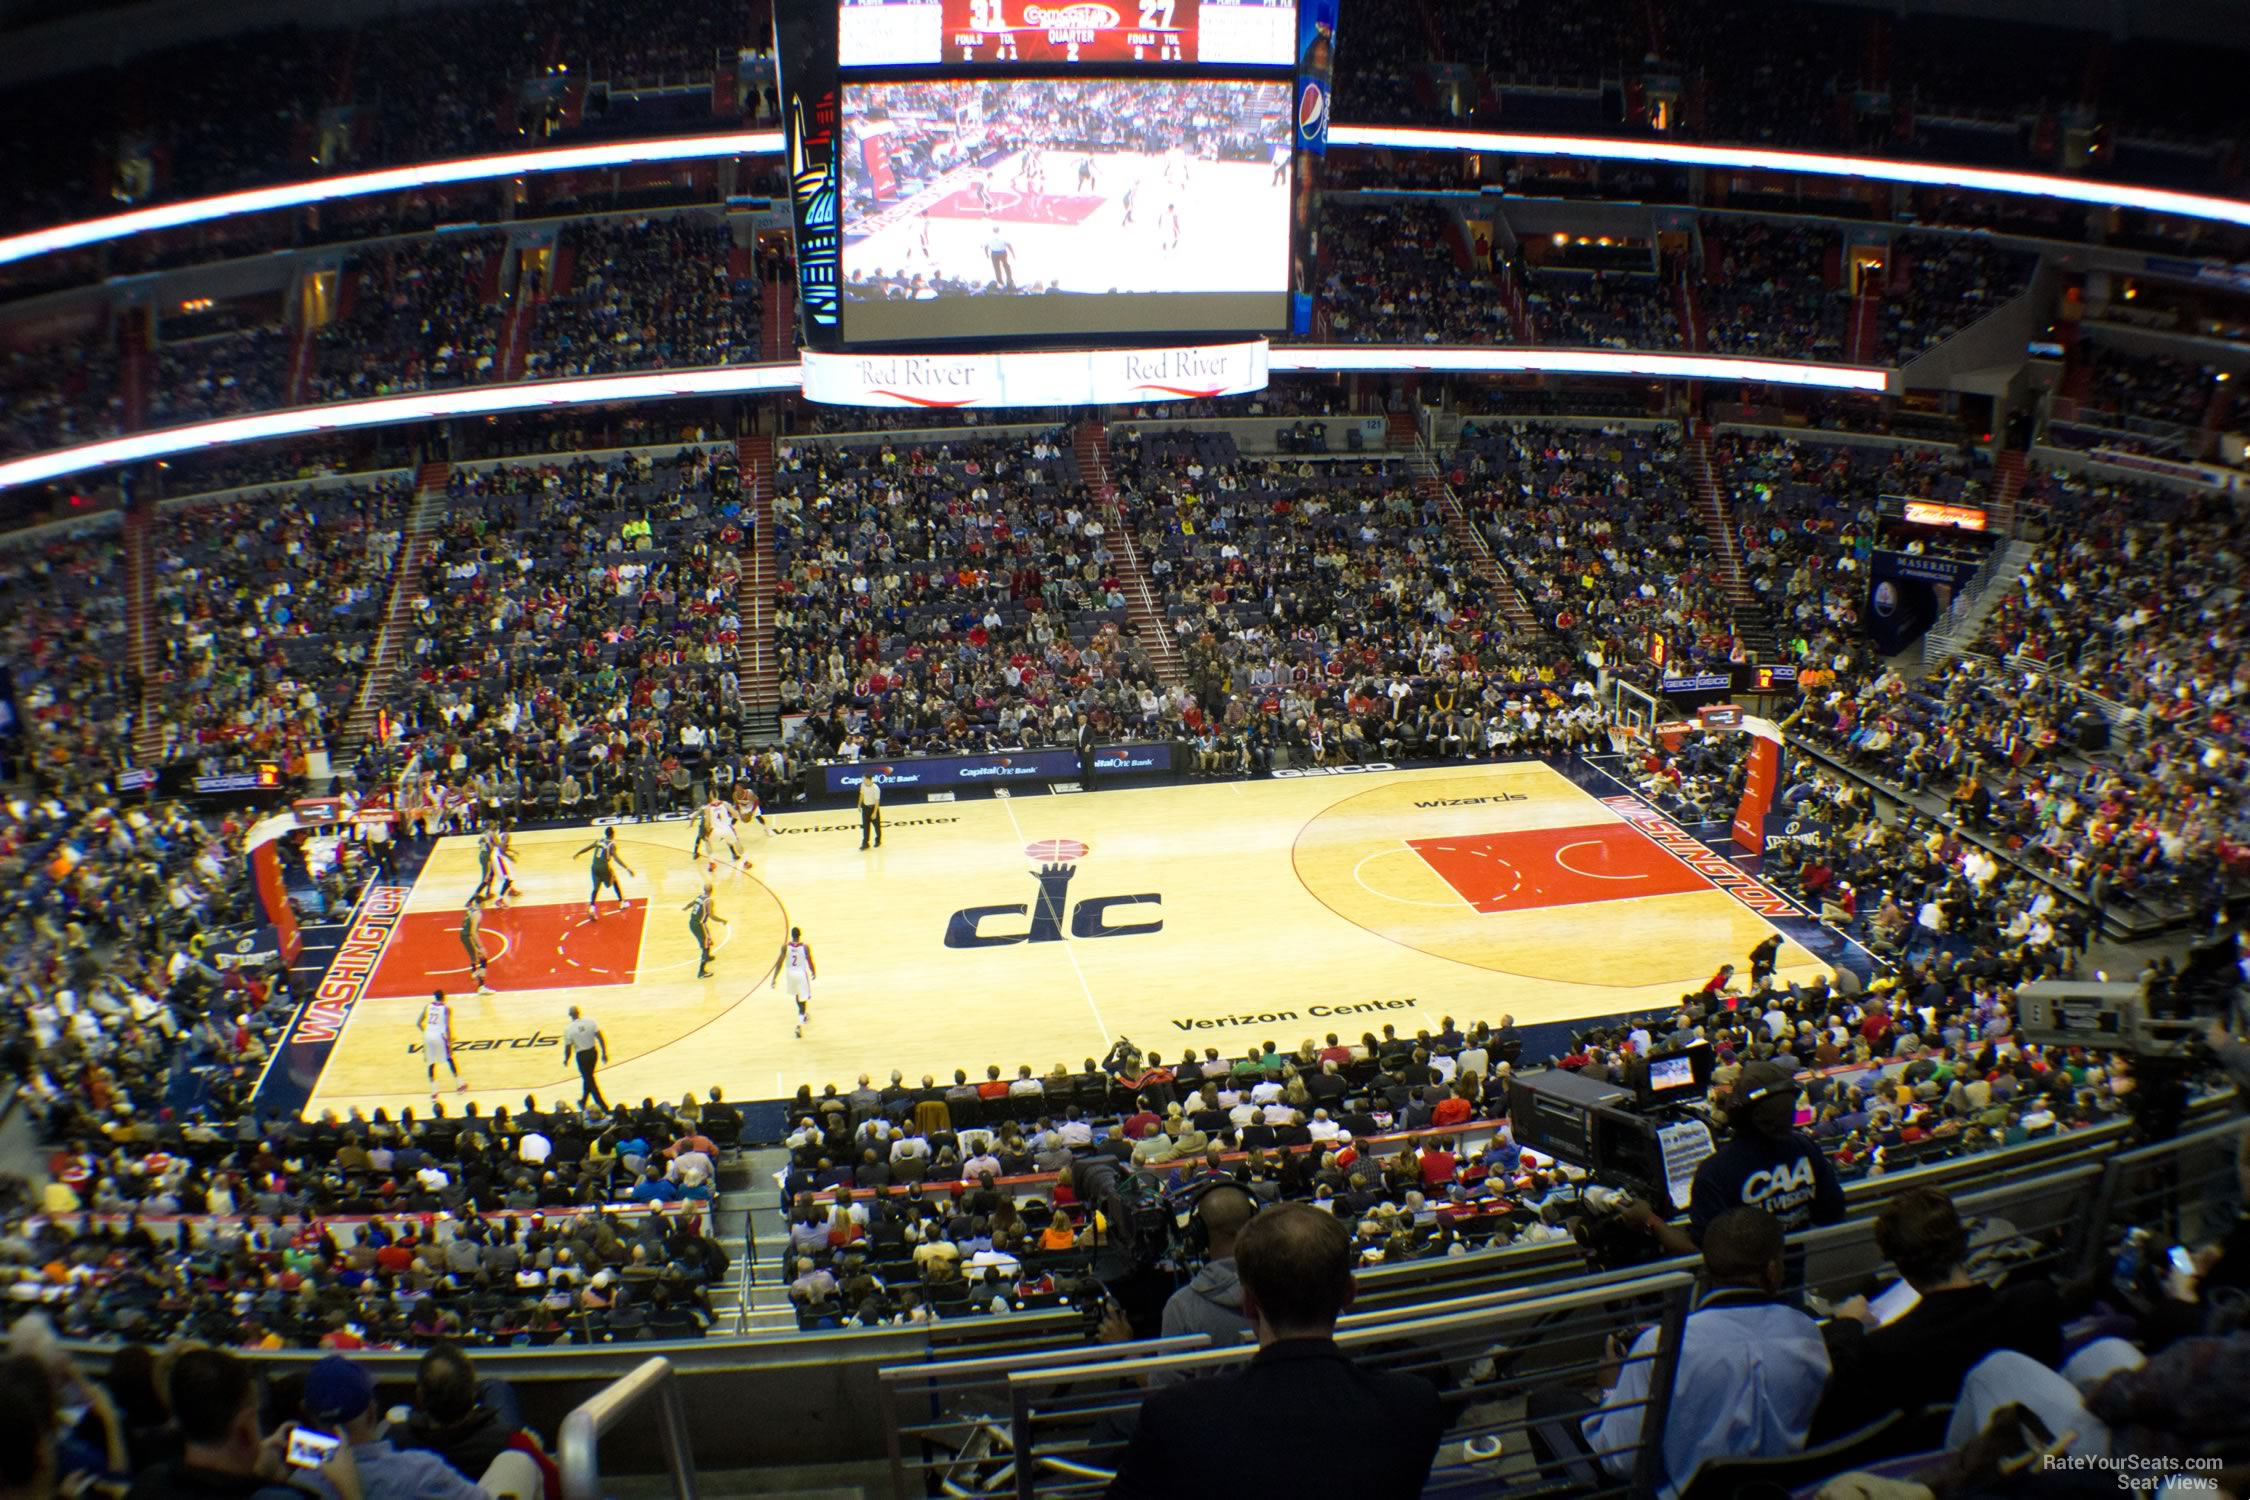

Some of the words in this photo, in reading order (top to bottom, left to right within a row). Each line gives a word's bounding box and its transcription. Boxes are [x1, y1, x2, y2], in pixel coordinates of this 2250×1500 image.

[1138, 0, 1176, 30] 27
[955, 34, 984, 46] FOULS
[1000, 34, 1016, 46] TOL
[1048, 30, 1095, 44] QUARTER
[1127, 33, 1155, 45] FOULS
[1164, 33, 1180, 45] TOL
[1067, 43, 1079, 61] 2
[861, 359, 897, 385] Red
[906, 358, 976, 386] River
[1126, 352, 1168, 380] Red
[1176, 349, 1228, 378] River
[1366, 420, 1381, 430] 121
[1904, 502, 1985, 530] Budweiser
[1665, 679, 1697, 688] GEICO
[1699, 677, 1729, 686] GEICO
[1015, 766, 1038, 774] Bank
[1131, 759, 1154, 767] Bank
[1272, 763, 1397, 778] GEICO
[897, 774, 920, 783] Bank
[1414, 792, 1529, 808] wizards
[773, 823, 865, 836] Verizon
[878, 816, 961, 829] Center
[1600, 795, 1805, 917] WASHINGTON
[291, 886, 411, 1043] WASHINGTON
[791, 955, 798, 966] 2
[428, 1013, 439, 1025] 22
[1171, 1011, 1299, 1032] Verizon
[1307, 997, 1417, 1018] Center
[1742, 1156, 1817, 1205] CAA
